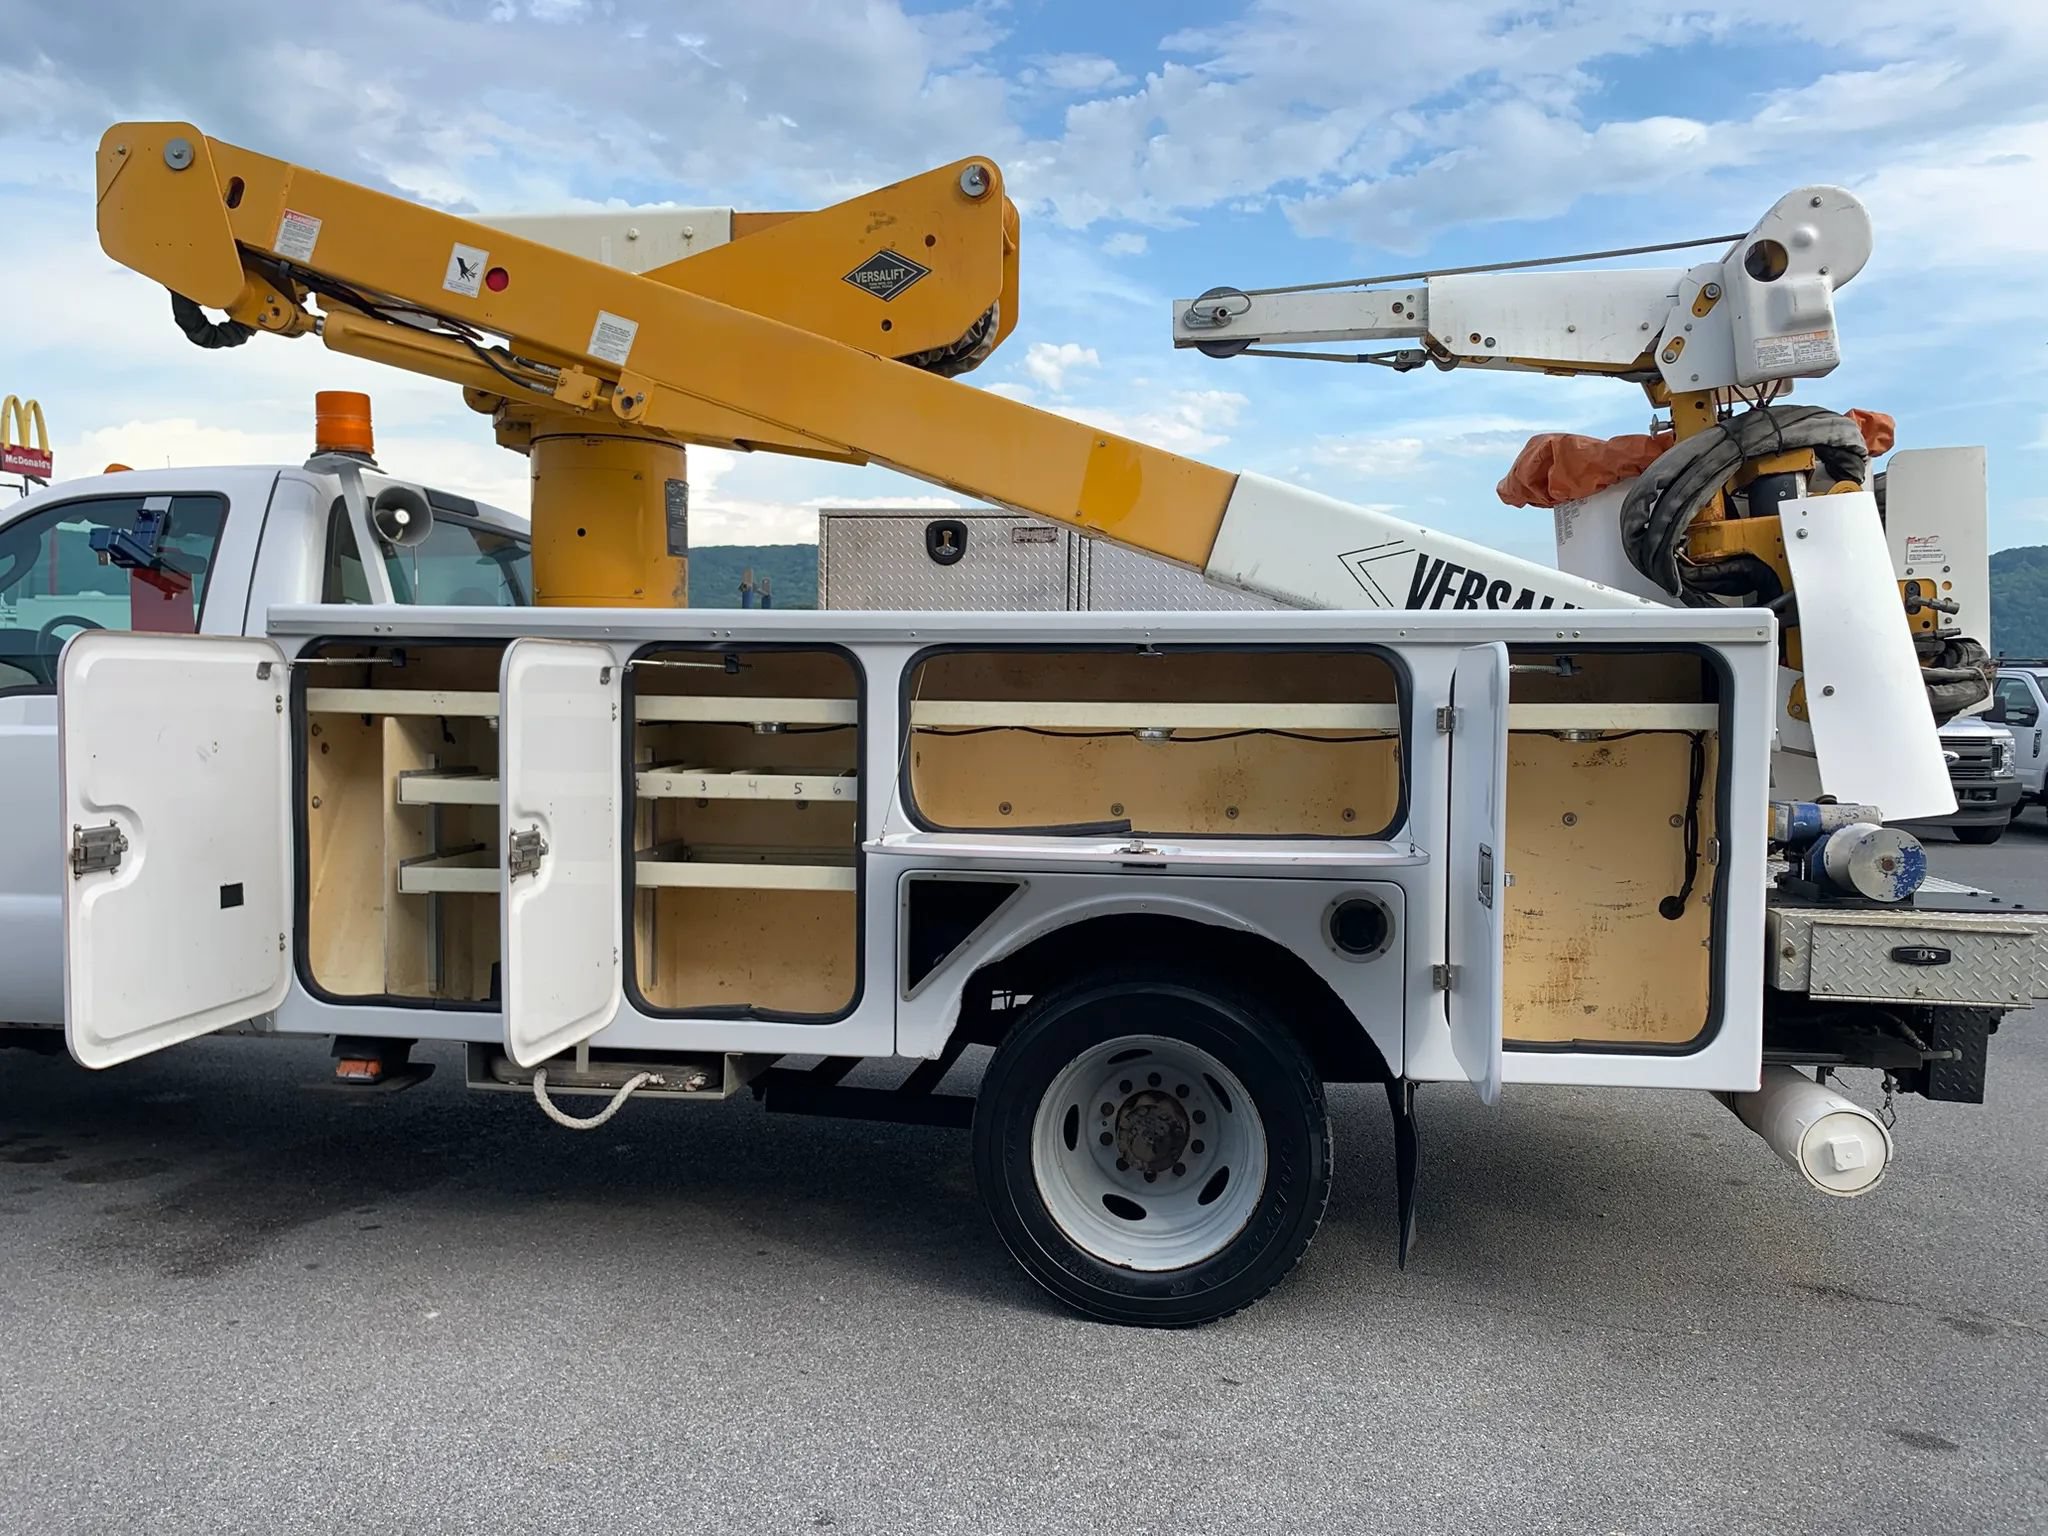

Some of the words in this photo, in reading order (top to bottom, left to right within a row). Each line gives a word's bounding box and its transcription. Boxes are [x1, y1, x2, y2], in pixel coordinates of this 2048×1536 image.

[855, 268, 905, 283] VERSALIFT
[1782, 333, 1816, 342] DANGER
[5, 454, 51, 469] McDonald's
[700, 780, 707, 791] 3
[748, 780, 758, 793] 4
[793, 782, 803, 795] 5
[832, 782, 841, 795] 6
